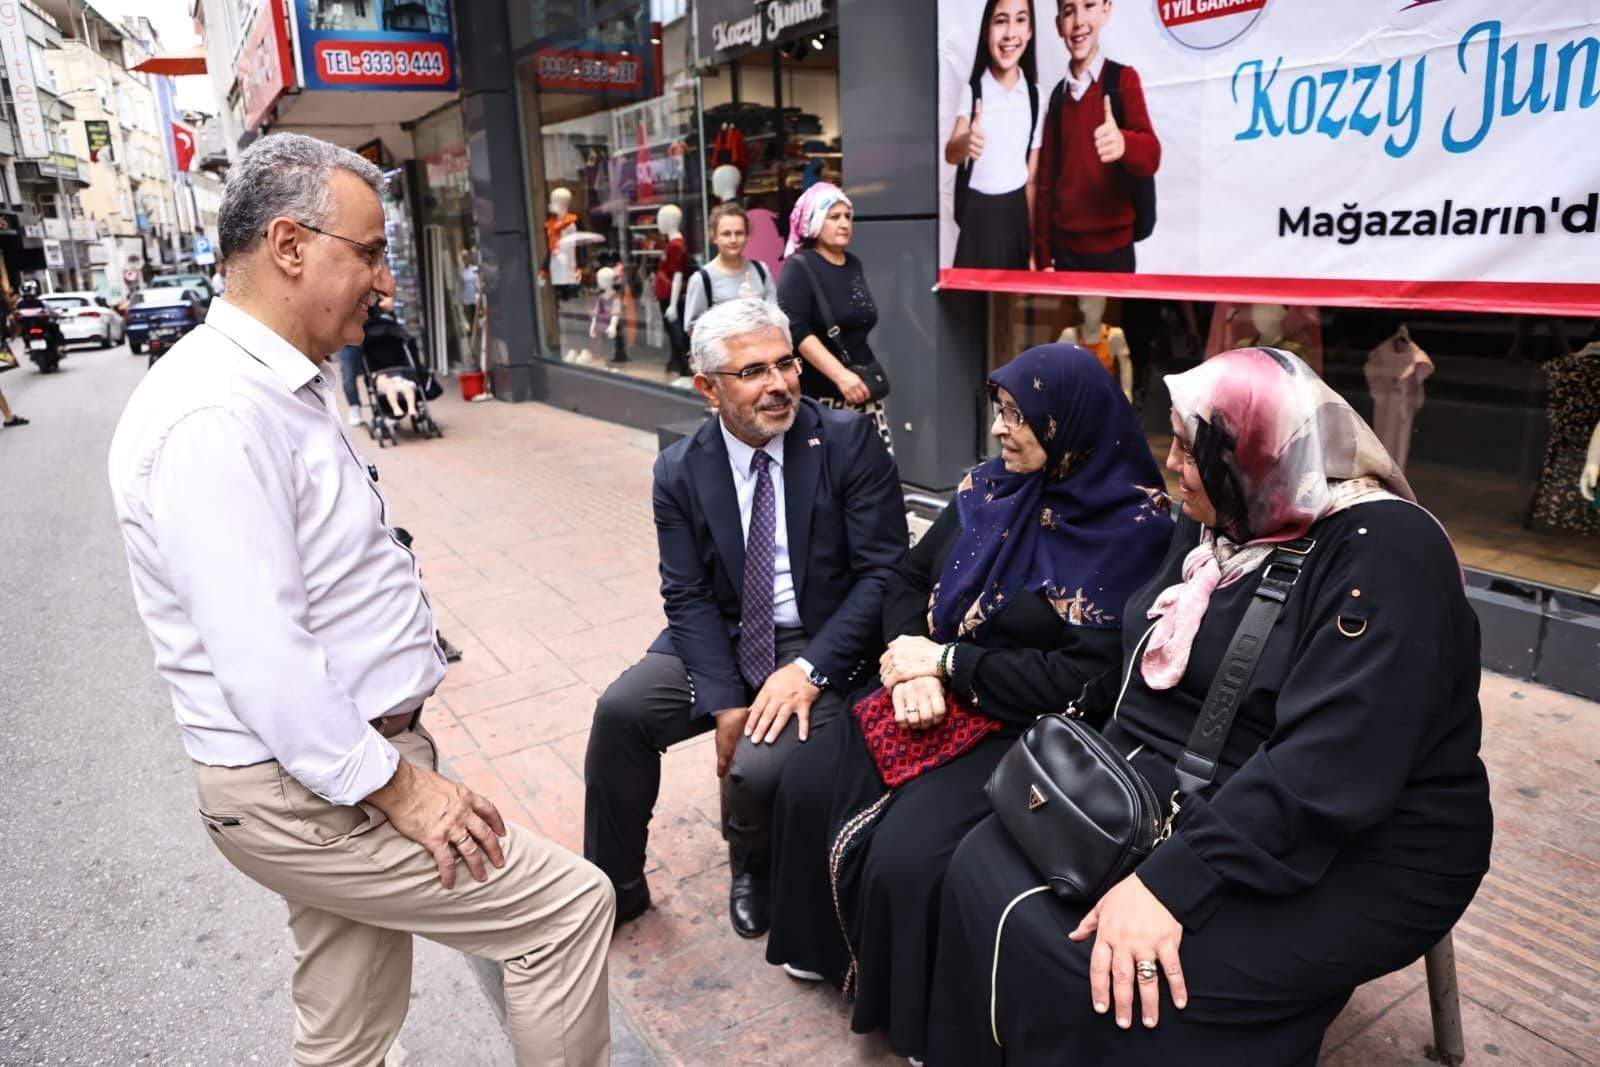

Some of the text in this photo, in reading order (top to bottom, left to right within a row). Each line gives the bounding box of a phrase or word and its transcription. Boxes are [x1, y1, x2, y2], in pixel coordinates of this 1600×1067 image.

[1162, 3, 1170, 20] 1
[712, 13, 762, 51] Kozzy
[361, 50, 394, 75] 333
[395, 50, 409, 75] 3
[410, 51, 444, 75] 444
[1231, 20, 1600, 158] Kozzy Jun
[1278, 192, 1600, 245] Mağazaların'd
